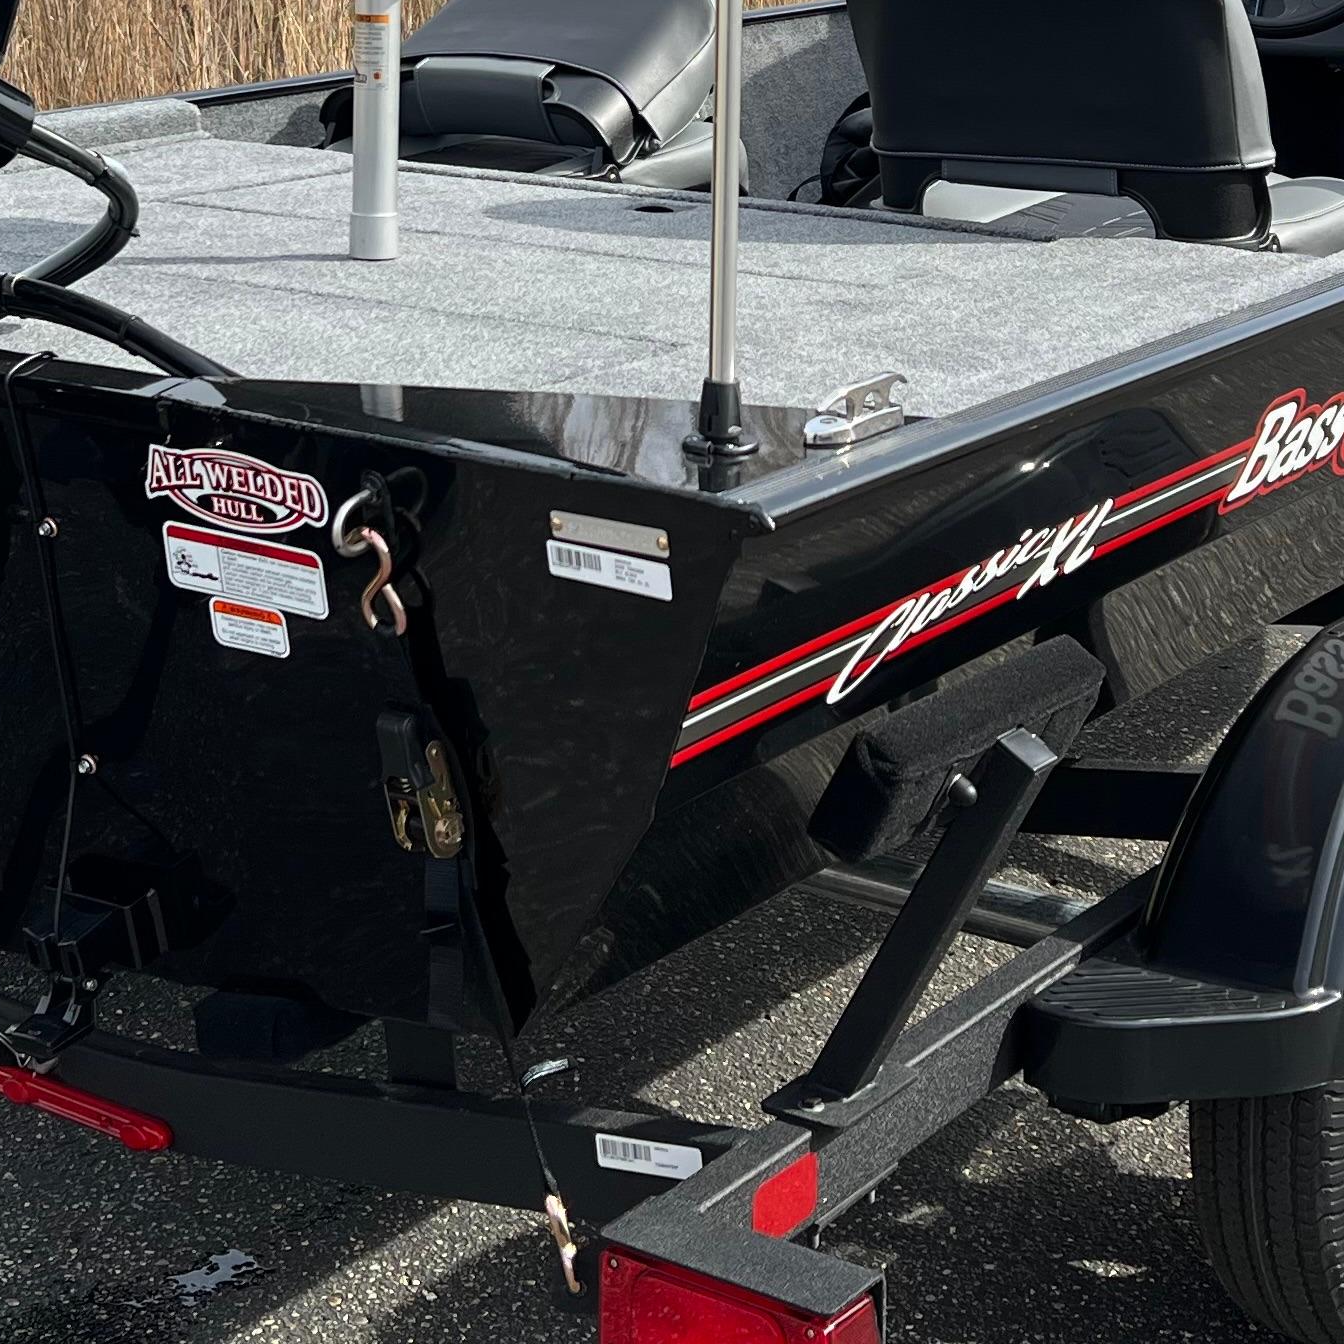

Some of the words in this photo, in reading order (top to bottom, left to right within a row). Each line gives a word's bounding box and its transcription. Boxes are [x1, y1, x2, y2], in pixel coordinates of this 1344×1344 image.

[150, 451, 202, 489] ALL
[203, 461, 322, 520] WELDED
[210, 496, 265, 522] HULL
[826, 528, 1056, 704] Classic
[1016, 498, 1114, 600] XL
